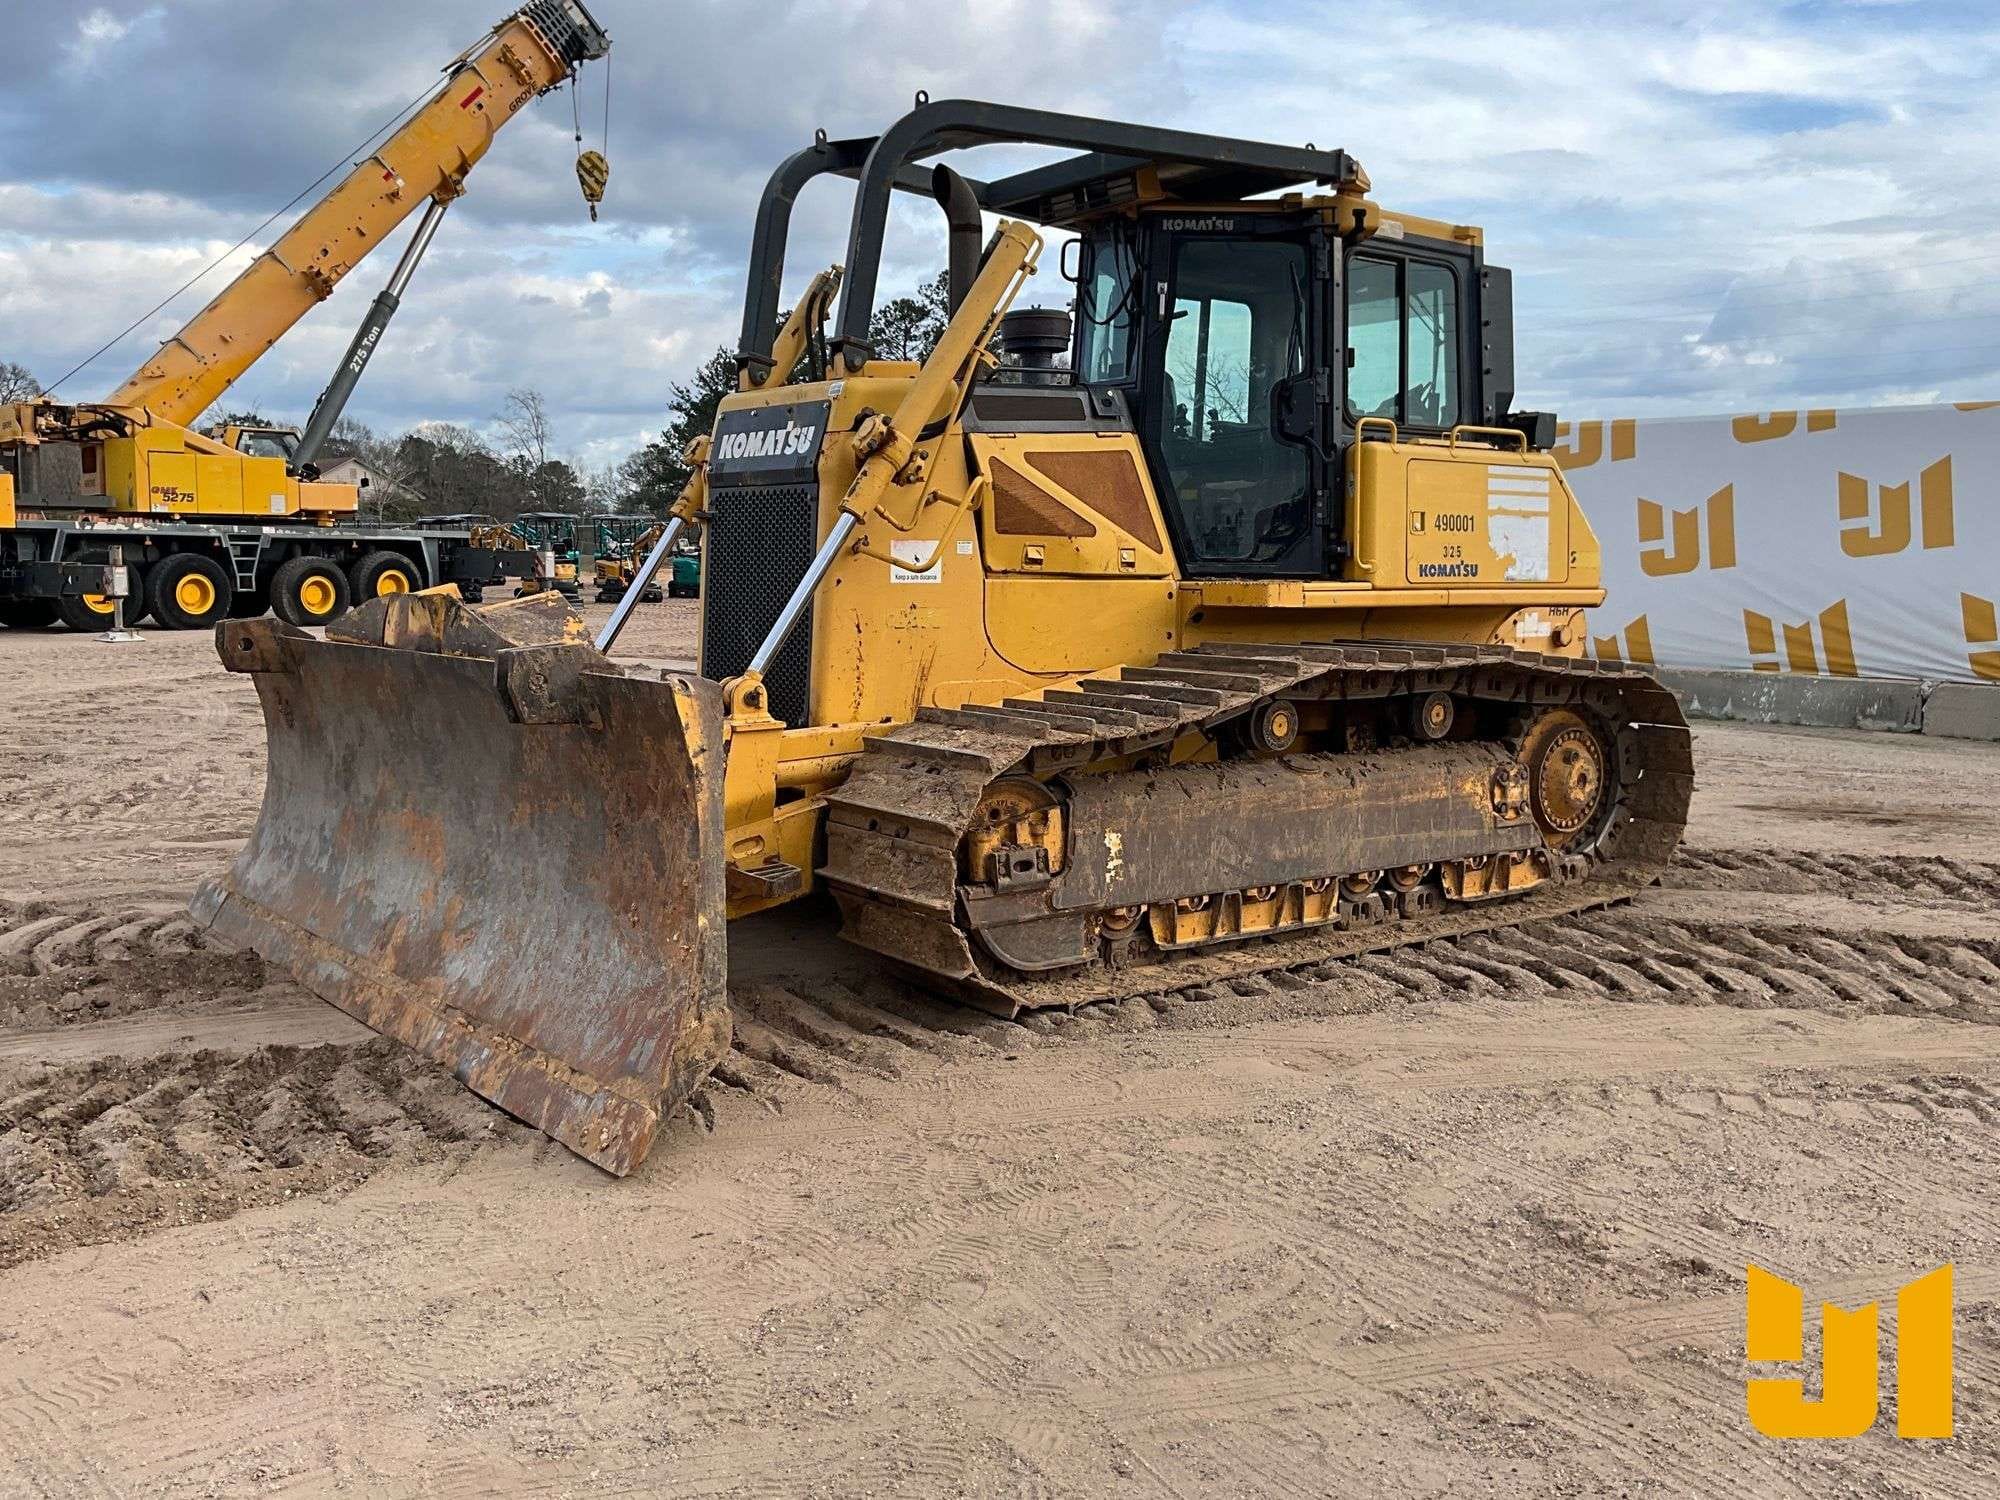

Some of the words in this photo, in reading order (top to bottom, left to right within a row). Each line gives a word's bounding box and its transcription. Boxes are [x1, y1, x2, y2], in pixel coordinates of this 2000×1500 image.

[508, 81, 538, 112] GROVE
[1162, 216, 1234, 231] KOMATSU
[350, 348, 367, 373] 275
[361, 326, 381, 347] Ton
[718, 420, 815, 460] KOMATSU
[162, 492, 195, 503] 5275
[1434, 514, 1475, 532] 490001
[1418, 560, 1479, 578] KOMATSU
